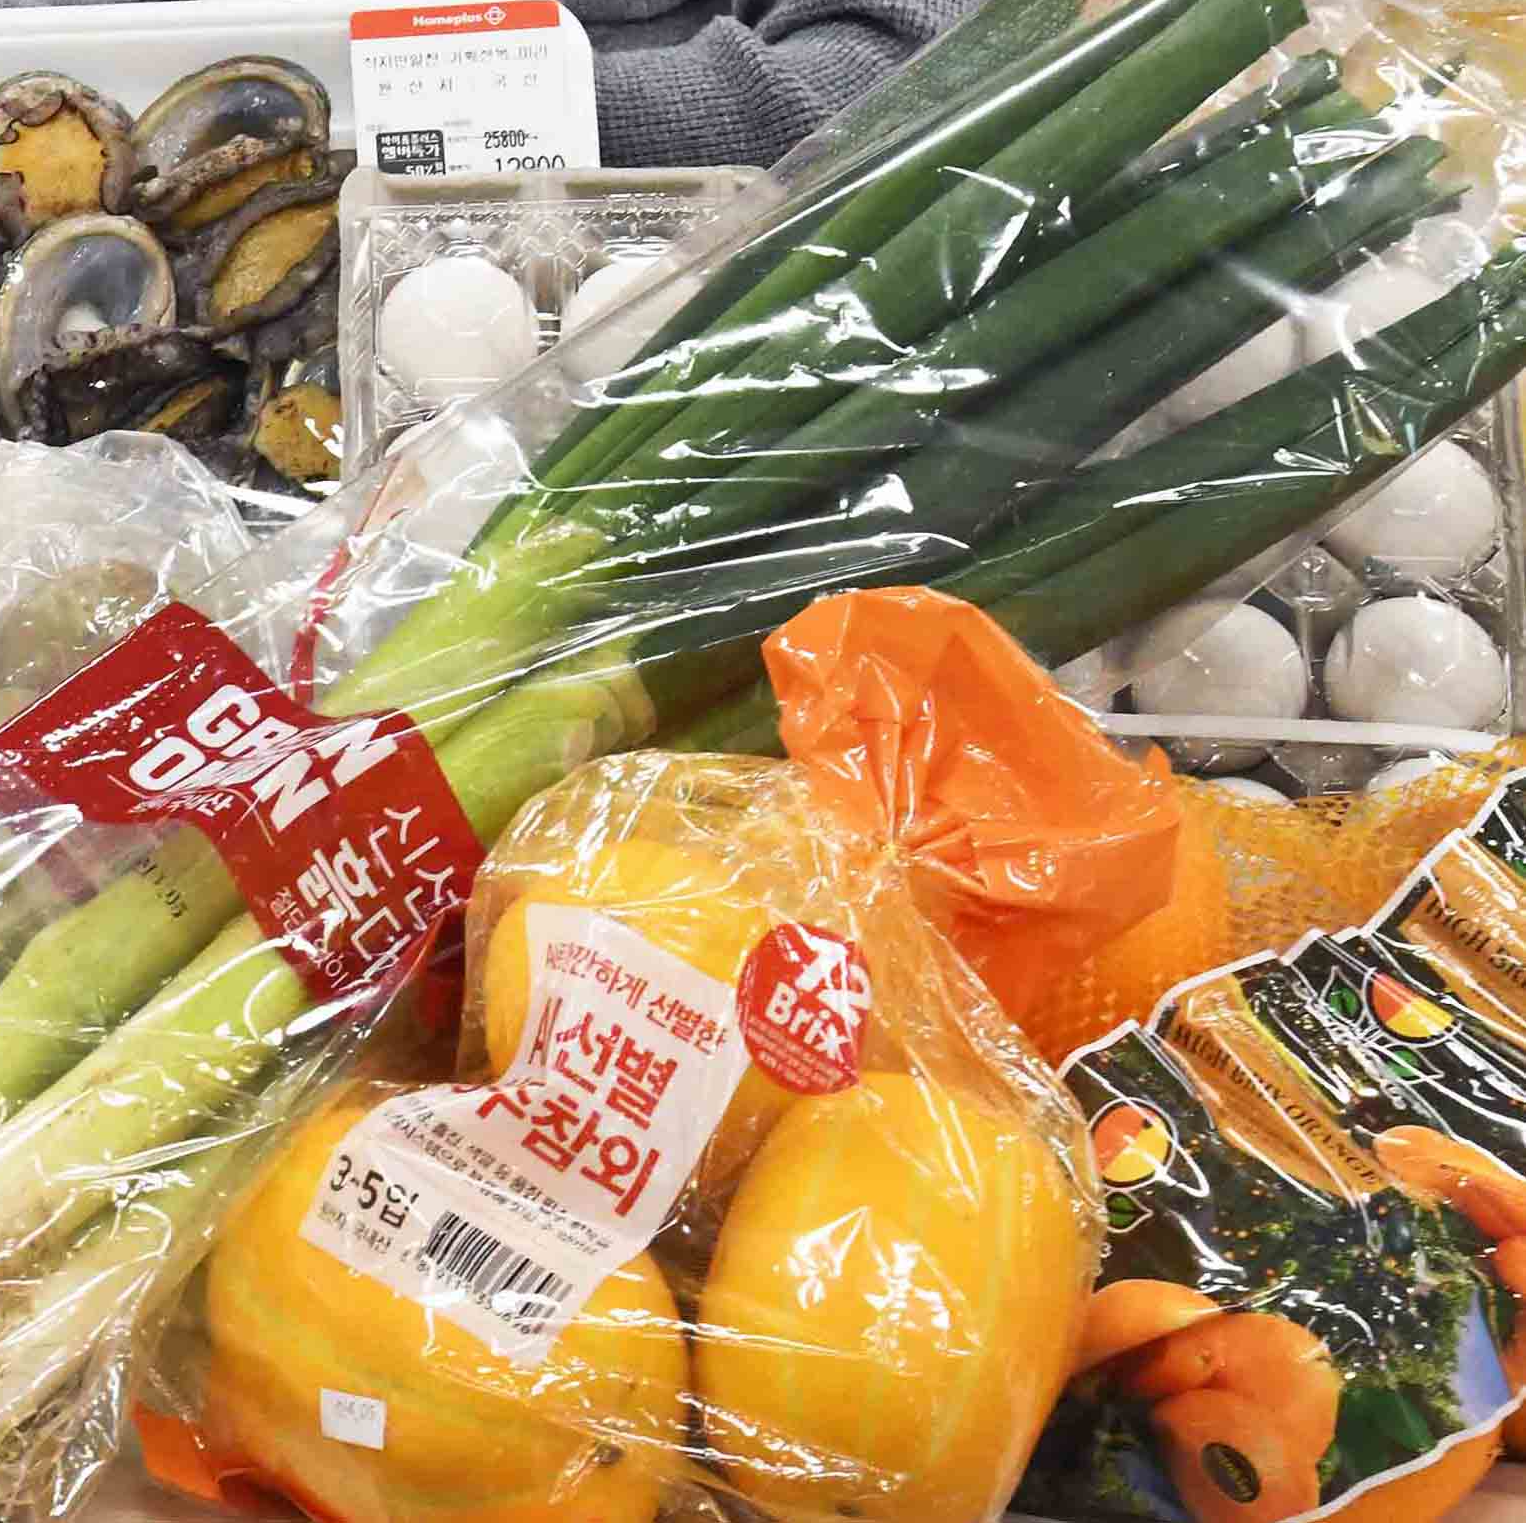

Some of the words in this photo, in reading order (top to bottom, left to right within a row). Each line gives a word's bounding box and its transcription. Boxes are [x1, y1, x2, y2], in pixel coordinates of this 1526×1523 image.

[412, 13, 483, 27] Homeplus
[483, 130, 525, 149] 25800
[1424, 894, 1492, 956] HIGH
[646, 991, 729, 1057] 선별한
[765, 982, 850, 1063] Brix
[552, 1011, 678, 1130] 선별
[1171, 1024, 1233, 1071] HIGH
[1285, 1104, 1380, 1187] ORANGE
